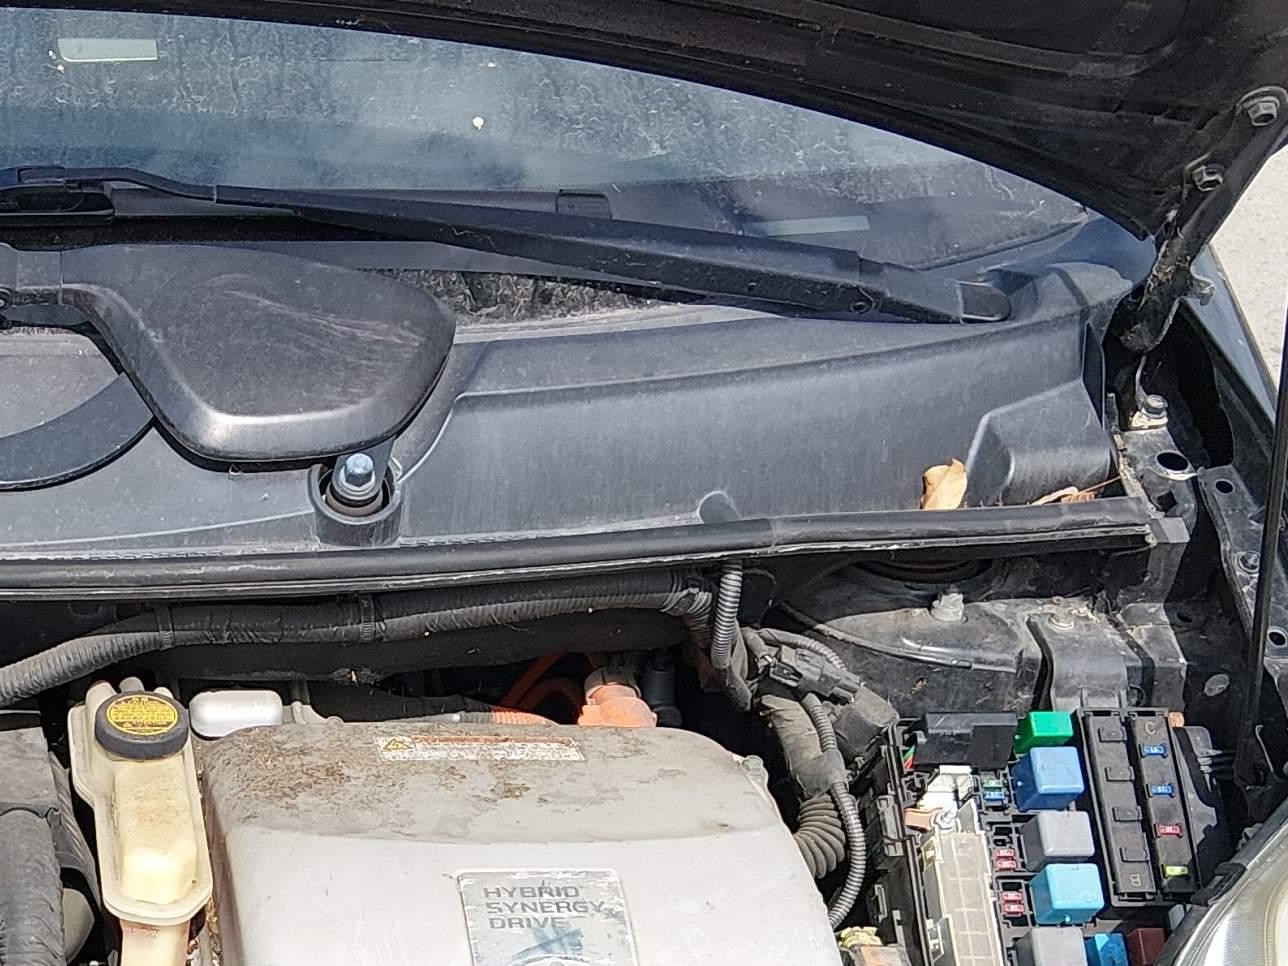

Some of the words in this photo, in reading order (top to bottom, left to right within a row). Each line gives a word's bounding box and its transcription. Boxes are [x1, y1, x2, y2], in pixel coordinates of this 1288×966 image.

[483, 886, 580, 898] HYBRID
[485, 901, 605, 914] SYNERGY
[489, 916, 570, 929] DRIVE
